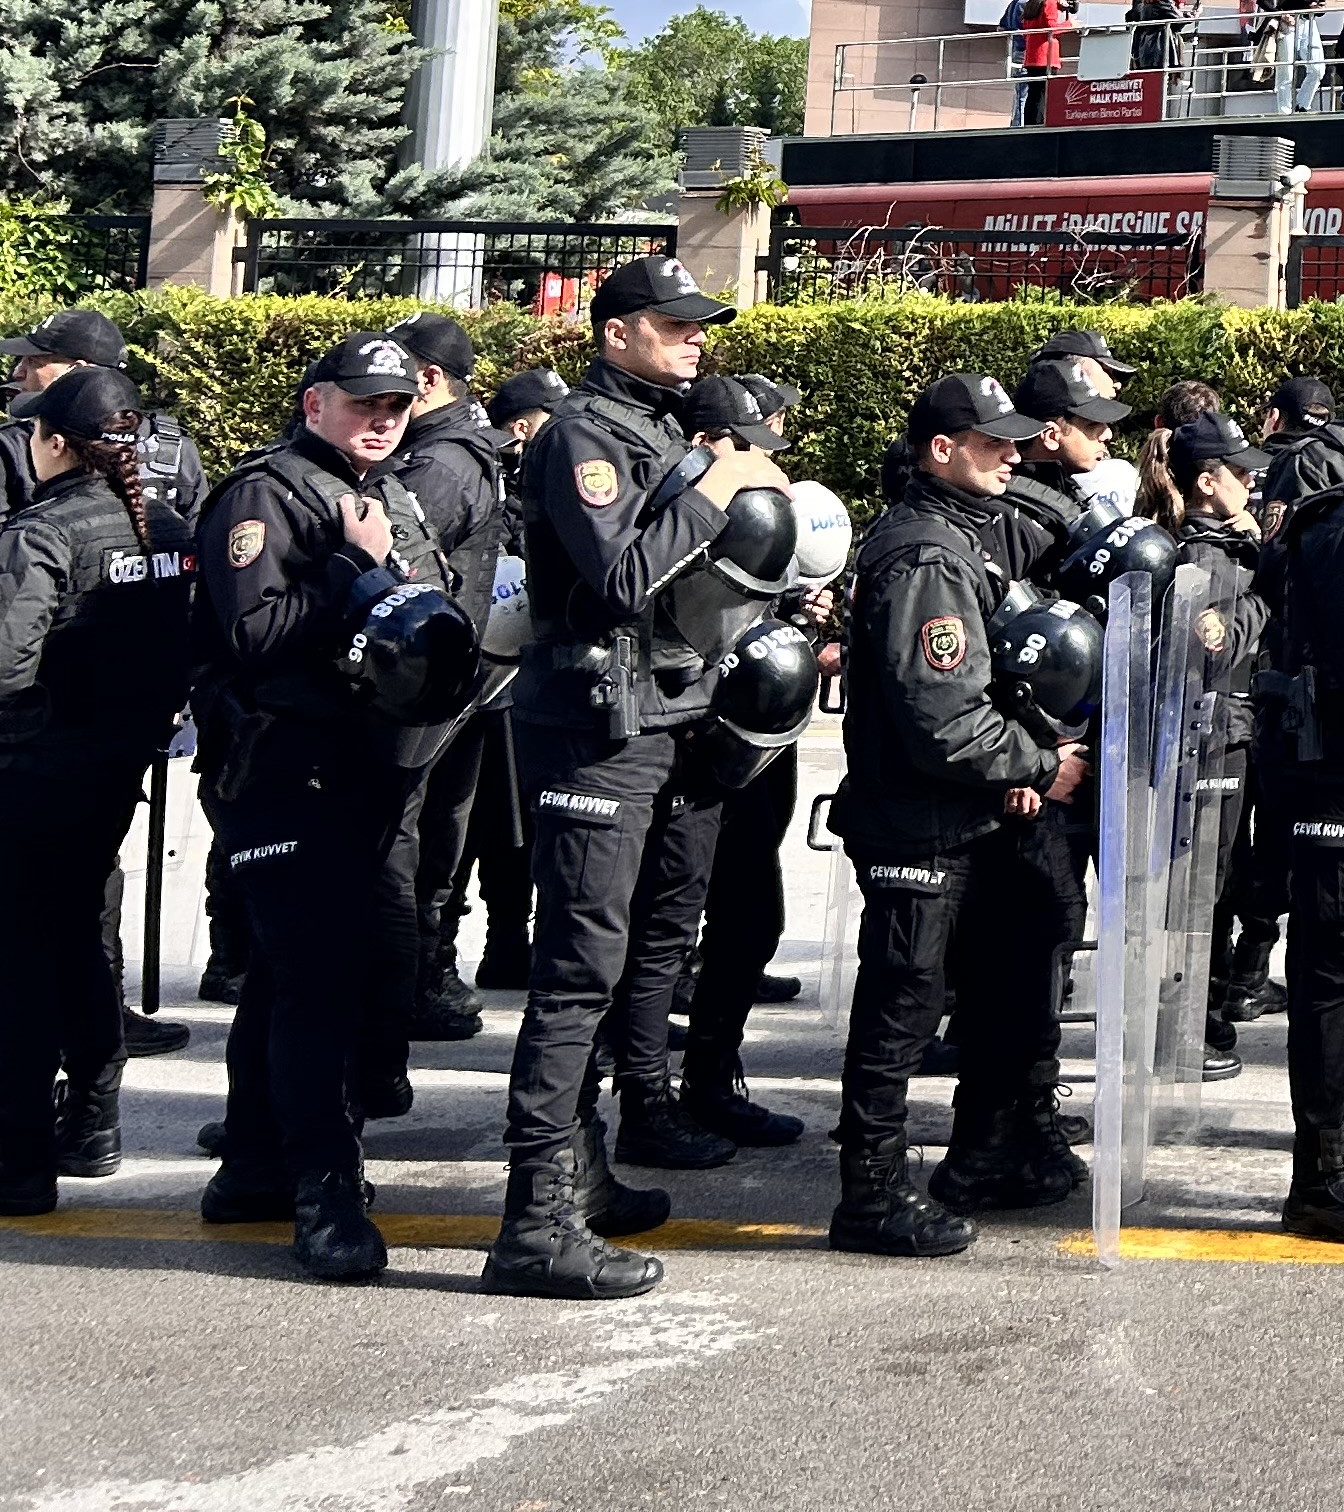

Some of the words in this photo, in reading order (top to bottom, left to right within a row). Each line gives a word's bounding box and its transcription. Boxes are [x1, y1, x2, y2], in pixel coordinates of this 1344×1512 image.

[1089, 92, 1112, 104] HALK
[1175, 210, 1204, 250] SA
[109, 550, 148, 584] ÖZE
[1089, 548, 1111, 576] 06
[348, 633, 368, 664] 06
[1017, 633, 1047, 665] 06
[570, 794, 621, 817] KUVVET
[253, 840, 299, 860] KUVVET
